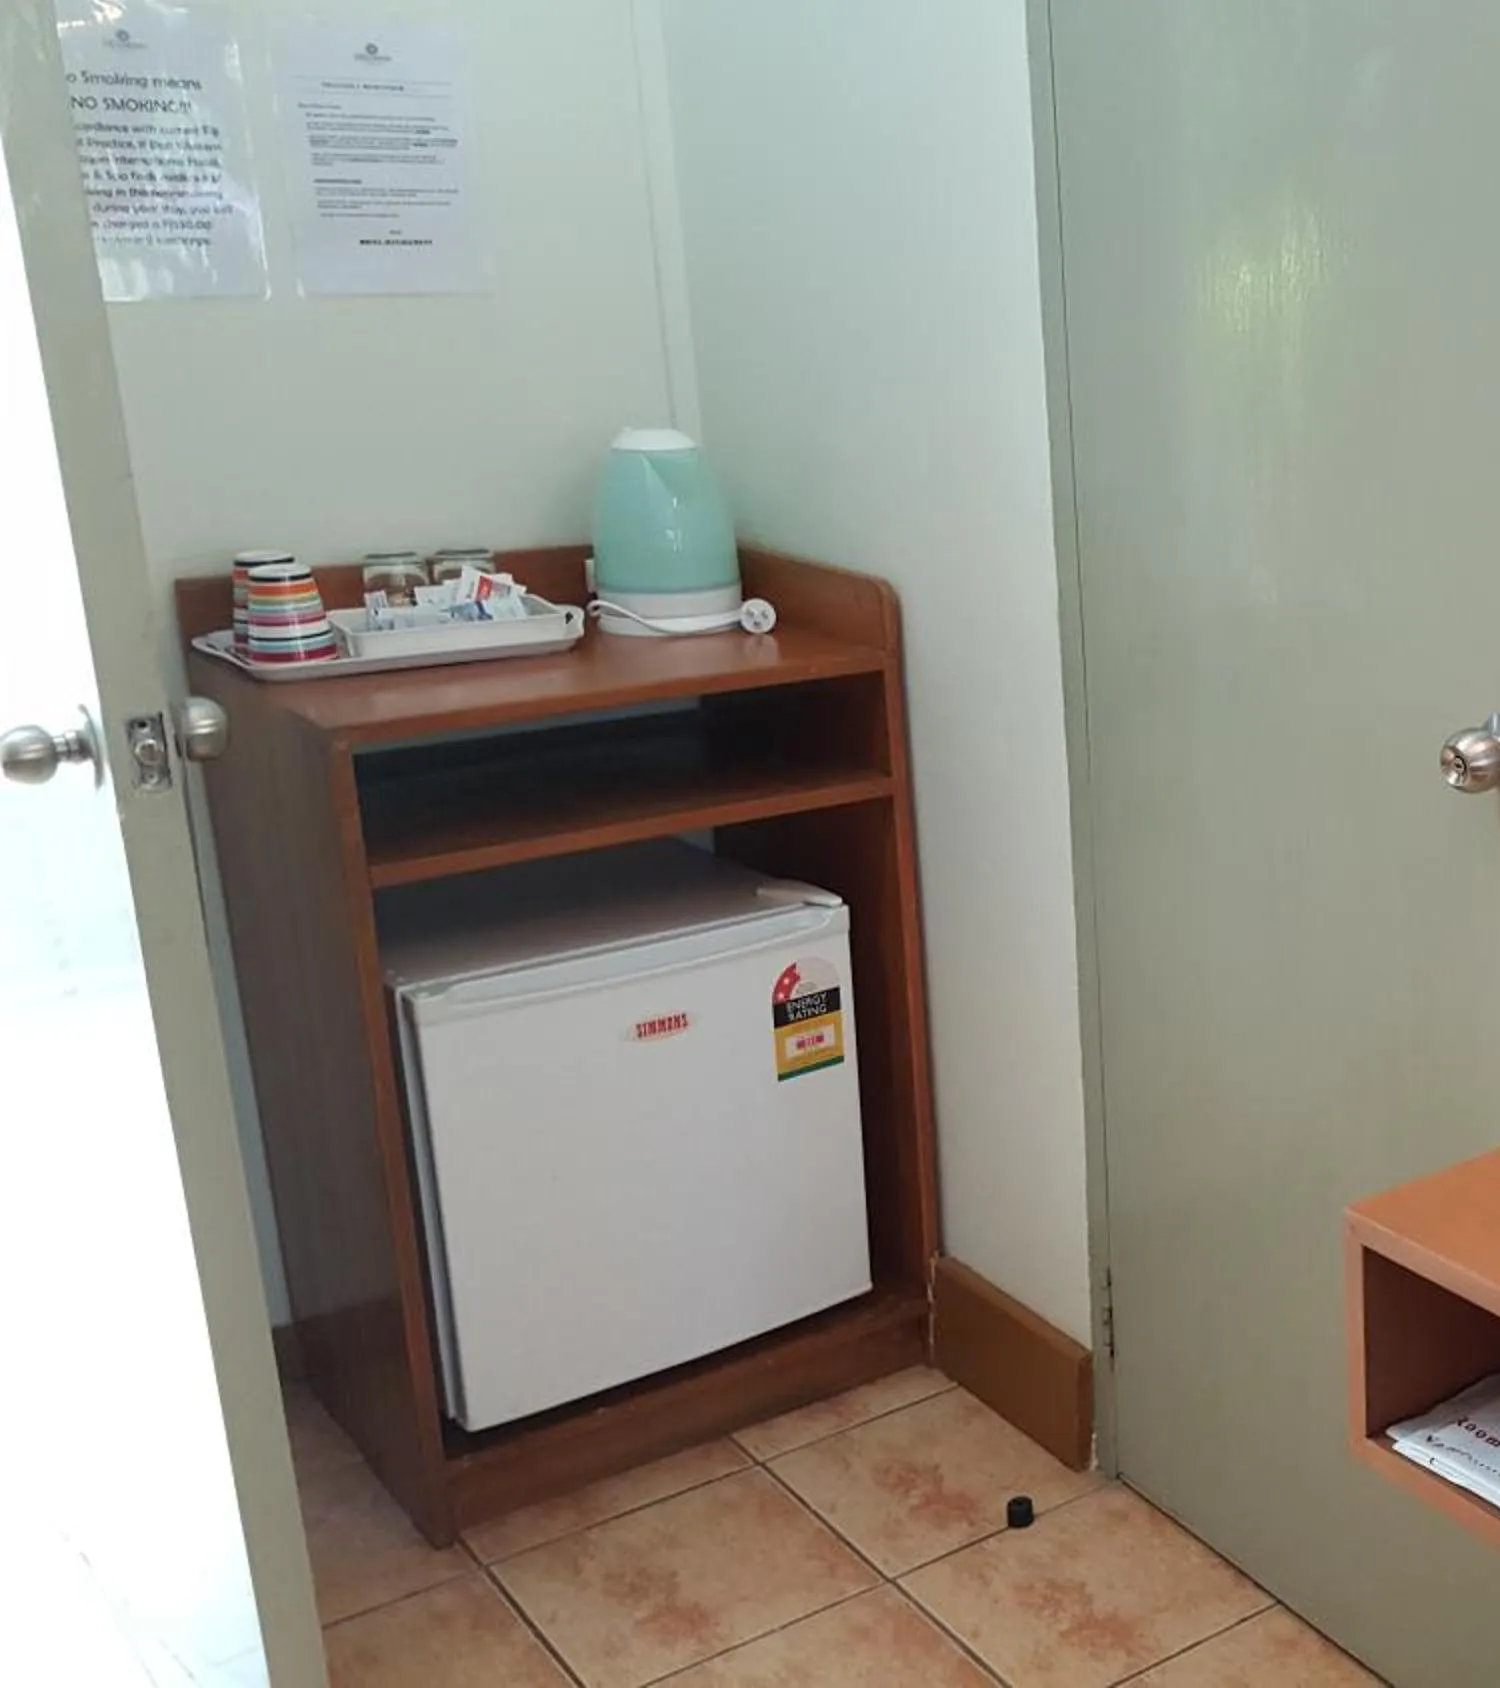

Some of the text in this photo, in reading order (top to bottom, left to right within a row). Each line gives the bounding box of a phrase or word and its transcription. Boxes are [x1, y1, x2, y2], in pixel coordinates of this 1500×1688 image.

[81, 71, 148, 89] Smoking
[152, 76, 202, 91] means
[71, 96, 98, 111] NO
